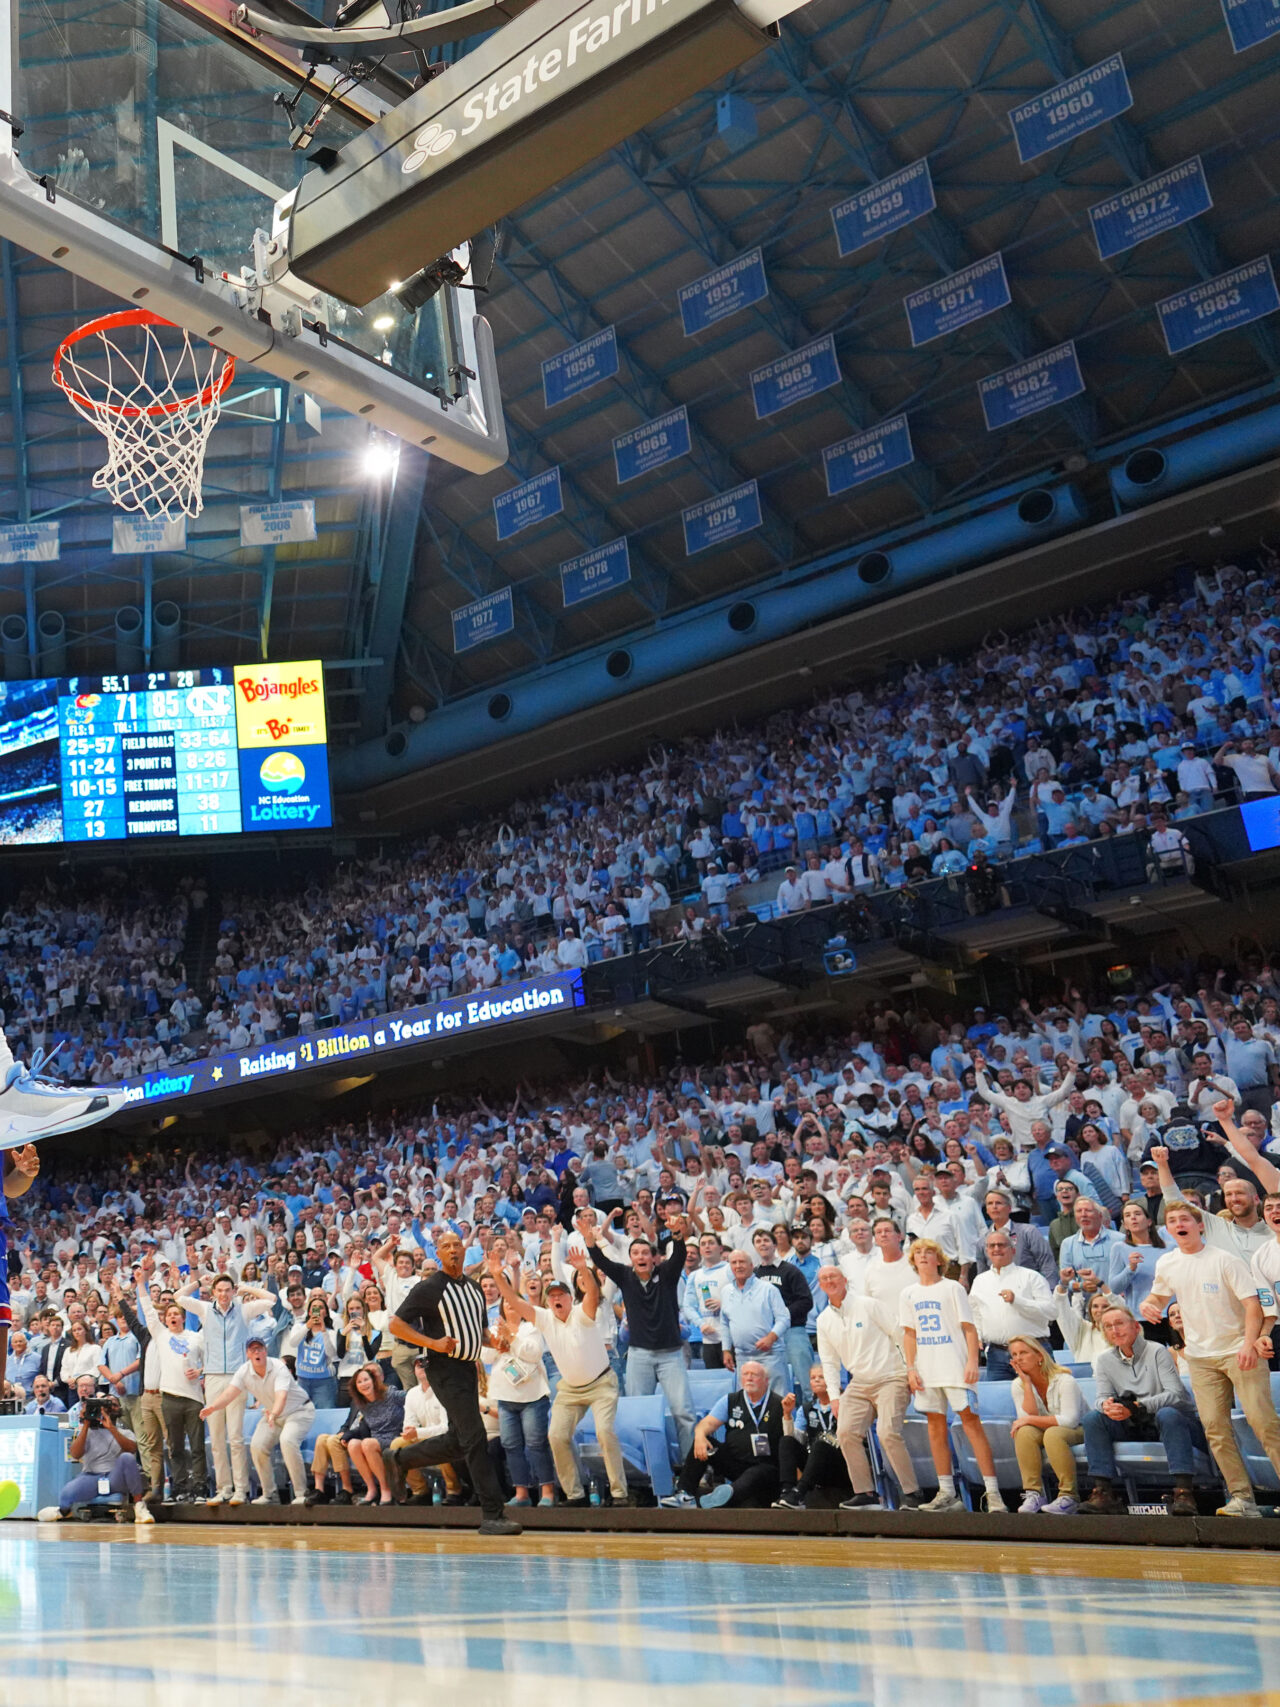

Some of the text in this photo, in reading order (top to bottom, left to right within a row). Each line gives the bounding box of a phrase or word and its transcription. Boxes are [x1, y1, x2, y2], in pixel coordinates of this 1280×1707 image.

[461, 48, 562, 136] State
[1014, 58, 1121, 123] ACC CHAMPIONS
[1046, 91, 1095, 125] 1960
[836, 164, 924, 219] ACC CHAMPIONS
[1093, 162, 1199, 220] ACC CHAMPIONS
[862, 191, 904, 223] 1959
[1127, 191, 1171, 224] 1972
[681, 251, 761, 302] ACC CHAMPIONS
[909, 257, 999, 309] ACC CHAMPIONS
[705, 278, 740, 305] 1957
[938, 285, 976, 313] 1971
[1161, 262, 1267, 316] ACC CHAMPIONS
[545, 330, 614, 375] ACC CHAMPIONS
[753, 339, 831, 386] ACC CHAMPIONS
[565, 353, 596, 379] 1956
[776, 364, 812, 391] 1969
[981, 345, 1072, 394] ACC CHAMPIONS
[1010, 370, 1051, 399] 1982
[636, 431, 668, 456] 1968
[851, 441, 885, 468] 1981
[514, 492, 542, 514] 1967
[706, 506, 737, 529] 1979
[582, 561, 608, 583] 1978
[471, 610, 494, 629] 1977
[102, 675, 130, 693] 55.1
[177, 671, 194, 687] 28
[238, 677, 319, 702] Bojangles
[115, 690, 179, 720] 71 85
[69, 725, 87, 736] FLS:
[133, 721, 138, 732] 1
[67, 736, 116, 756] 25-57
[122, 735, 174, 750] FIELD GOALS
[180, 730, 231, 749] 33-64
[69, 757, 116, 776] 11-24
[126, 756, 173, 770] 3 POINT FG
[186, 751, 227, 769] 8-26
[70, 778, 117, 797] 10-15
[124, 777, 177, 792] FREE THROWS
[185, 771, 229, 790] 11-17
[83, 793, 220, 817] 27 REBOUNDS 38
[258, 794, 310, 805] NC Education
[251, 804, 319, 822] Lottery
[85, 815, 219, 838] 13 TURNOVERS 11
[239, 988, 564, 1077] Raising $1 Billion a Year for Education
[145, 1074, 194, 1097] Lottery
[918, 1314, 942, 1331] 23
[303, 1348, 320, 1365] 15
